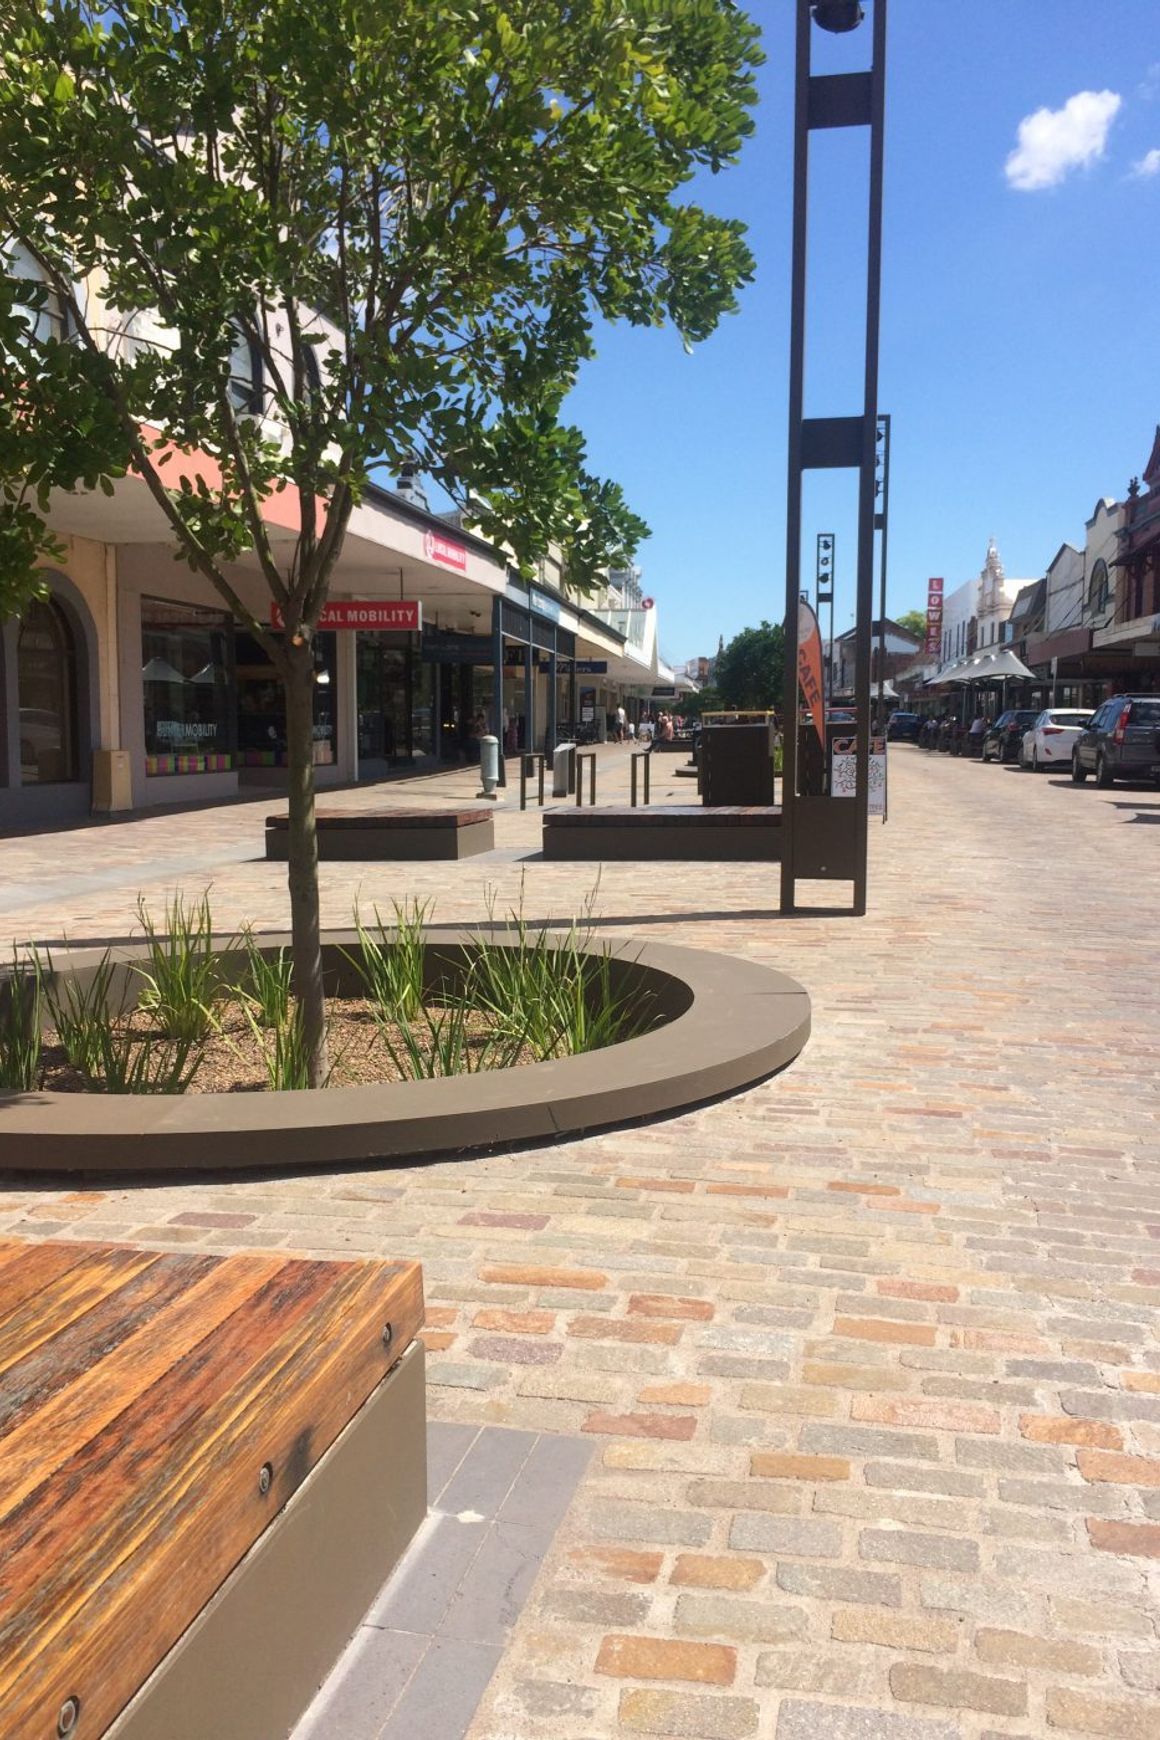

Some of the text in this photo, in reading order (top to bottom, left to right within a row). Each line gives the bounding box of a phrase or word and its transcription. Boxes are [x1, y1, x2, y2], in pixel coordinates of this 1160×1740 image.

[347, 609, 414, 622] MOBILITY
[927, 579, 942, 653] LOWES
[799, 648, 821, 707] CAFE
[185, 723, 218, 737] MOBILITY
